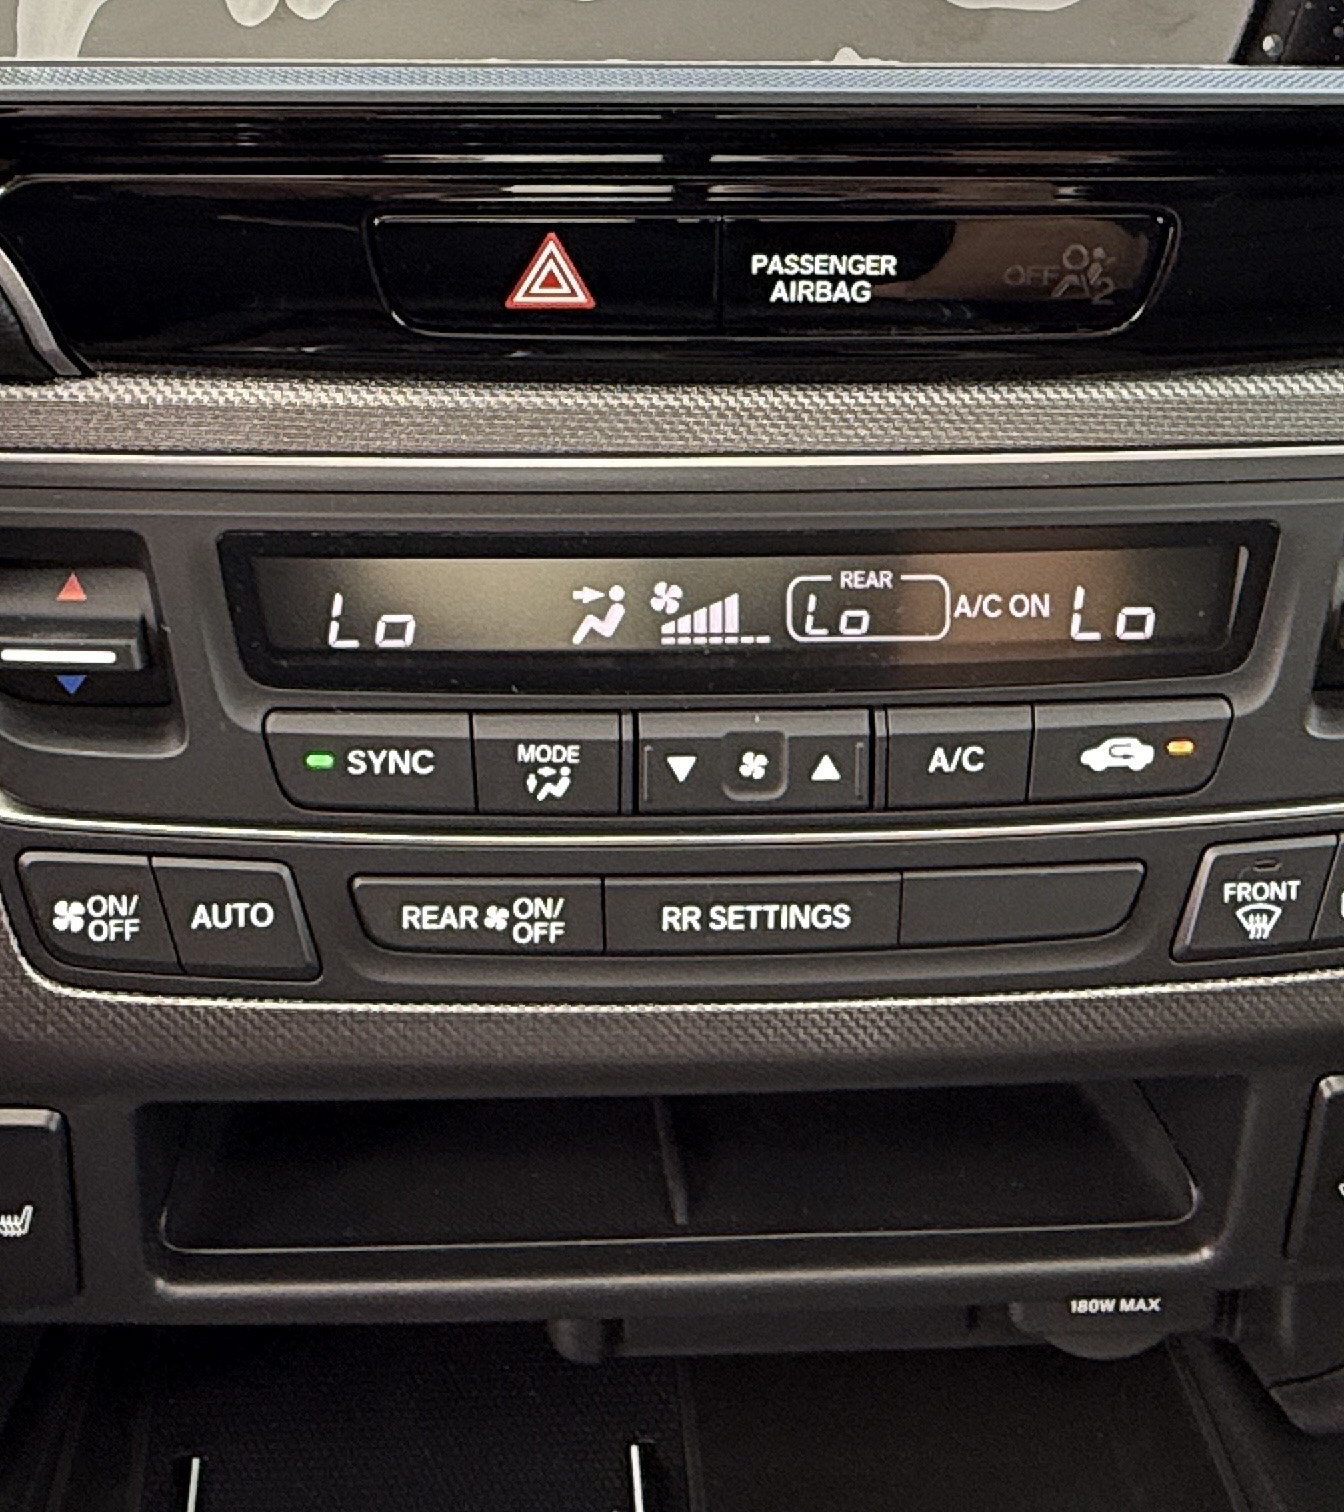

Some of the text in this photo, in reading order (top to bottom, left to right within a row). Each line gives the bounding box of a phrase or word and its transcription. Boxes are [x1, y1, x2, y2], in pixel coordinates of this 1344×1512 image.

[750, 254, 897, 277] PASSENGER
[1006, 264, 1056, 285] OFF
[769, 280, 872, 304] AIRBAG
[840, 570, 894, 589] REAR
[806, 593, 870, 637] Lo
[954, 594, 1051, 619] A/C ON
[1069, 585, 1157, 642] Lo
[328, 592, 416, 648] Lo
[346, 749, 435, 777] SYNC
[517, 744, 580, 764] MODE
[928, 747, 984, 774] A/C
[1223, 880, 1301, 904] FRONT
[87, 894, 138, 916] ON/
[190, 902, 275, 931] AUTO
[513, 897, 564, 919] ON/
[401, 905, 478, 931] REAR
[661, 904, 852, 931] RR SETTINGS
[89, 918, 140, 942] OFF
[512, 920, 565, 944] OFF
[1070, 1298, 1161, 1314] 180W MAX
